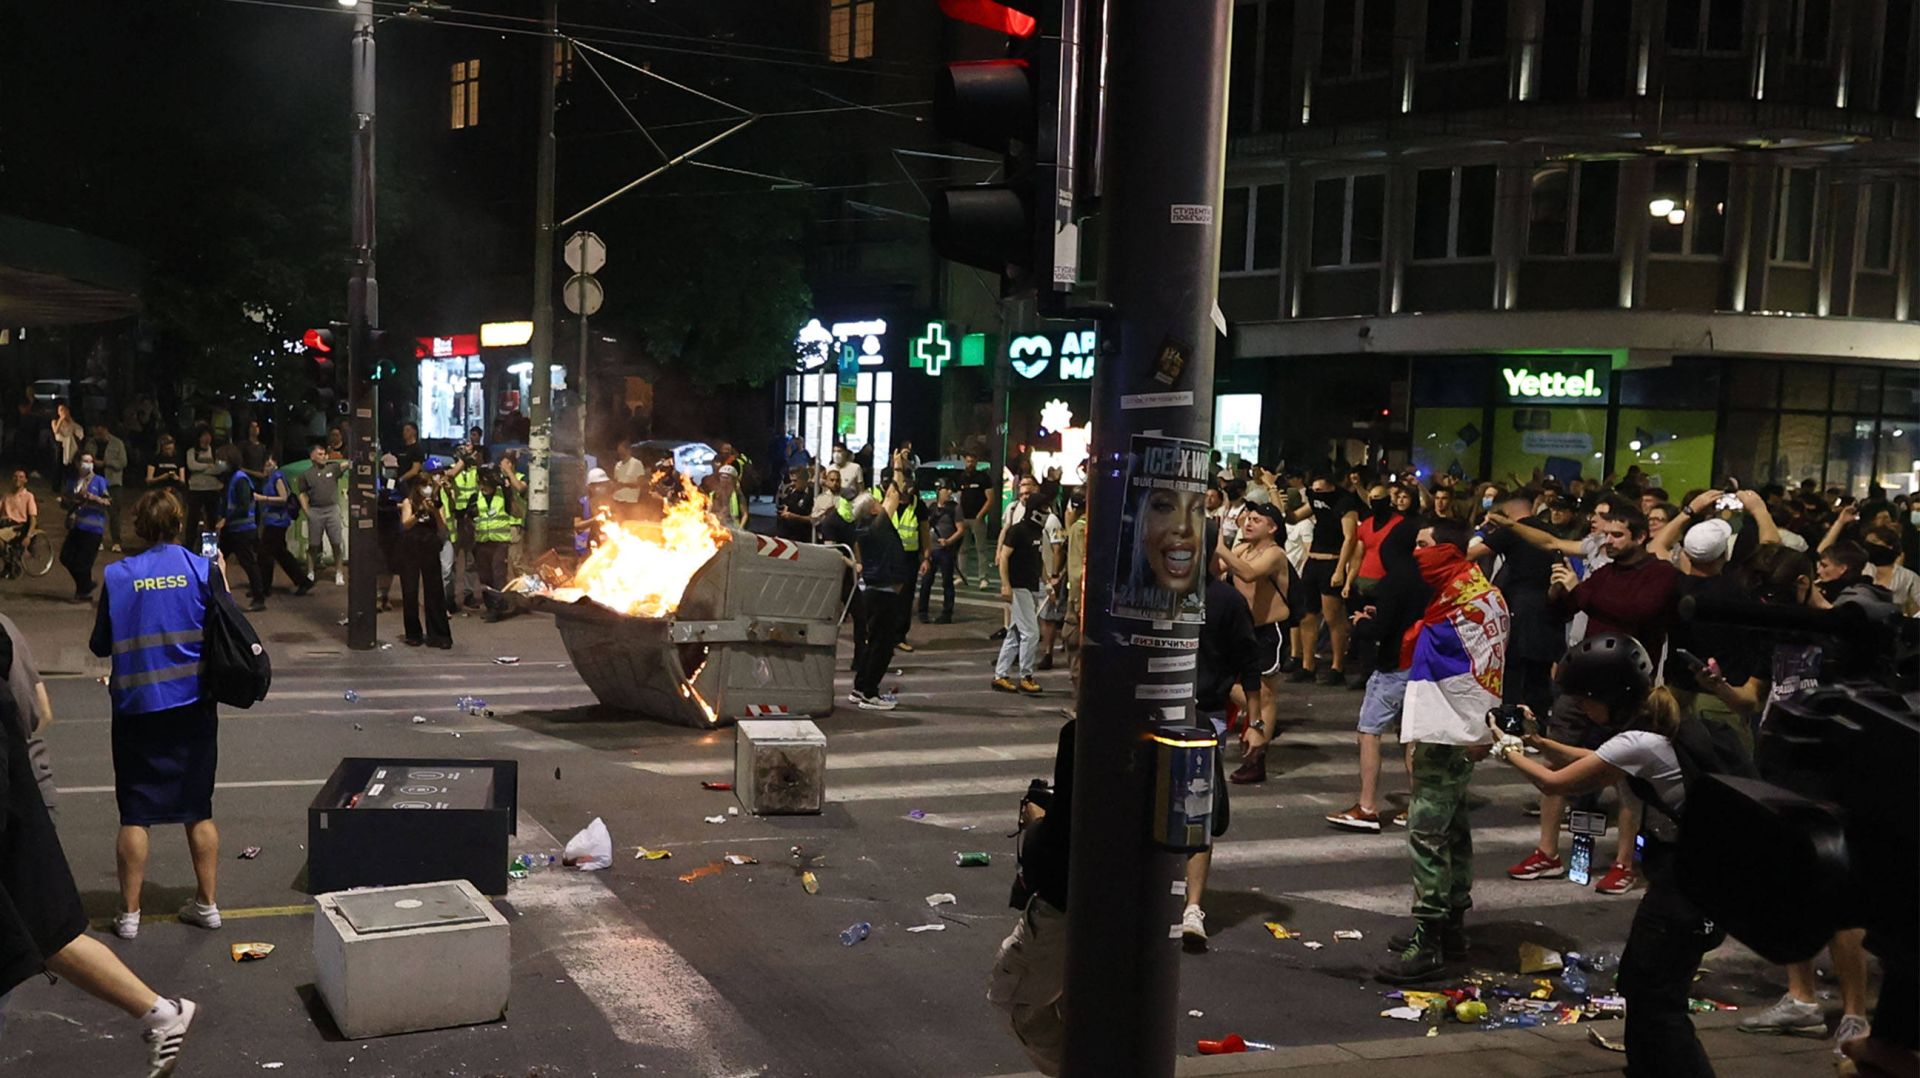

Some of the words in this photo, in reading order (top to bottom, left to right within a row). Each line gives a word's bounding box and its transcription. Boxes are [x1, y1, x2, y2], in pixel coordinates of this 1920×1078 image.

[844, 346, 855, 367] P
[1503, 368, 1601, 397] Yettel.
[133, 575, 187, 592] PRESS
